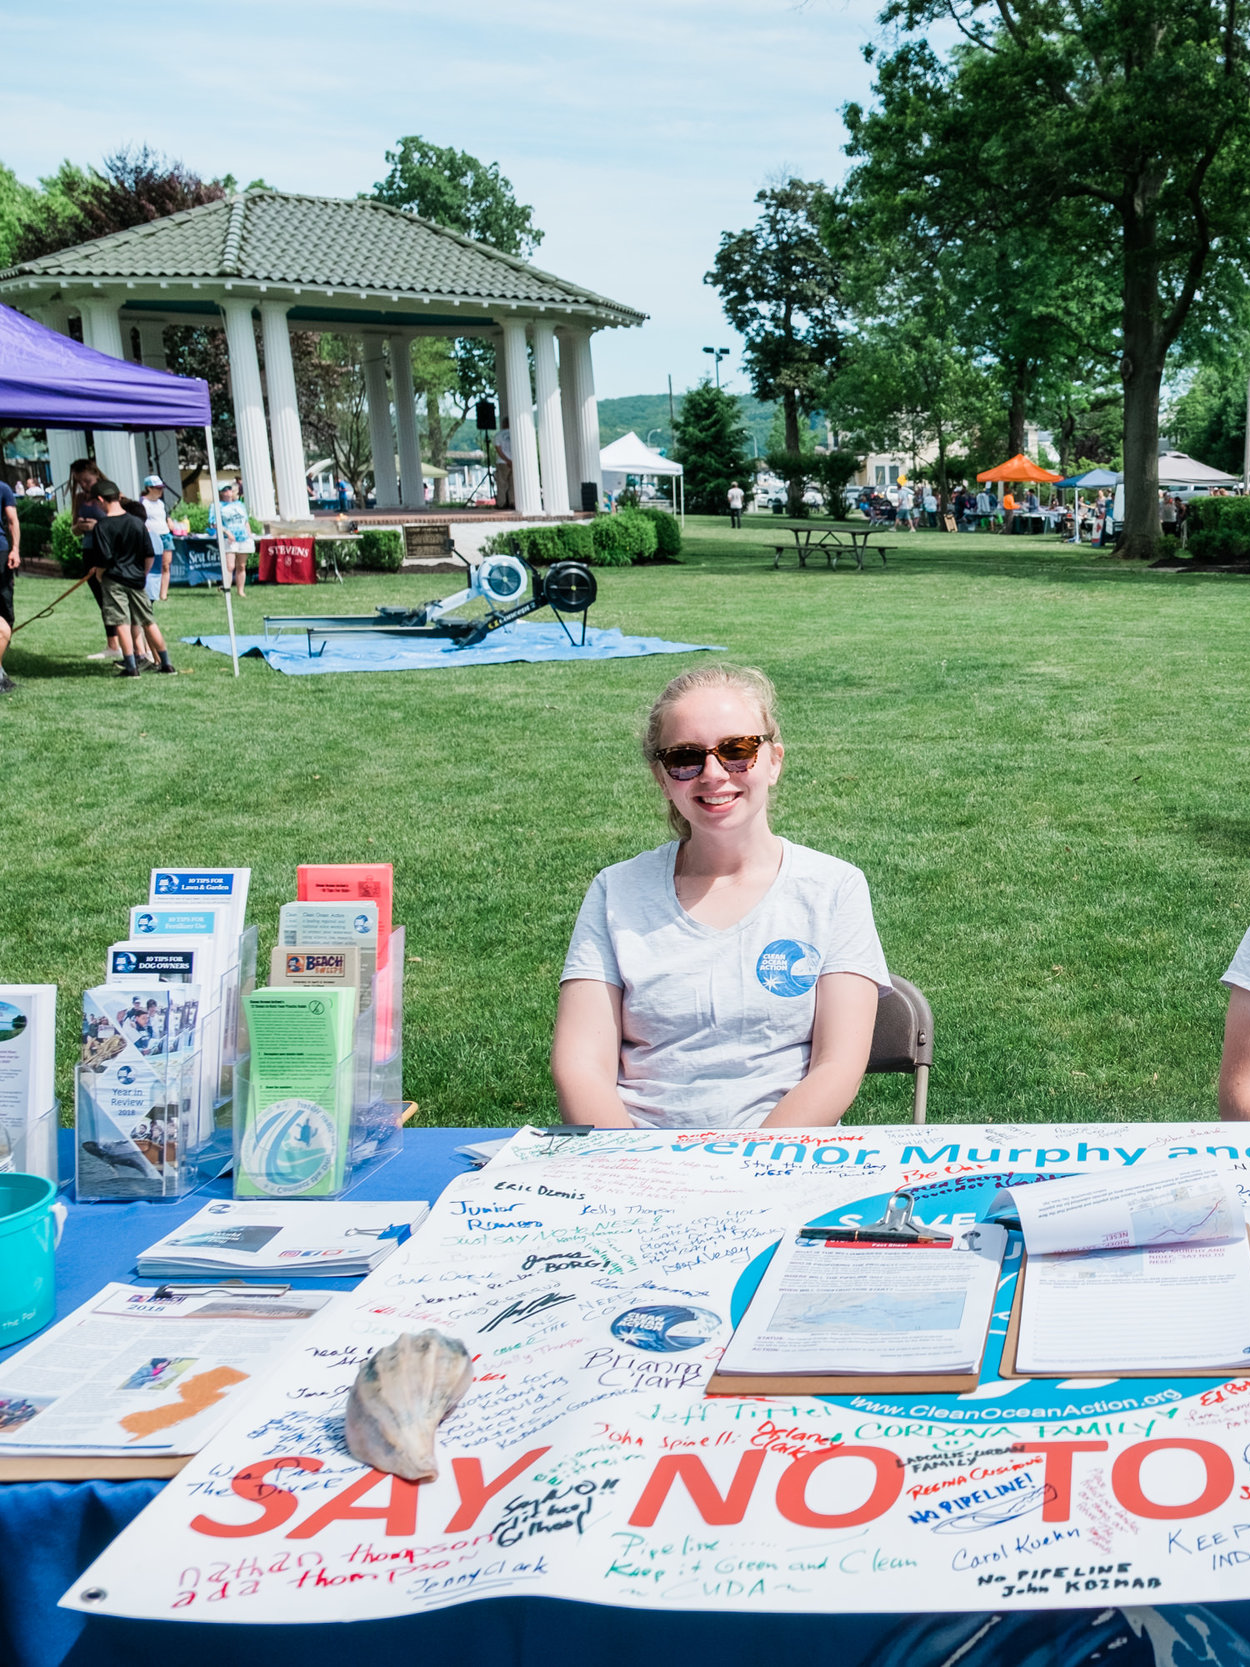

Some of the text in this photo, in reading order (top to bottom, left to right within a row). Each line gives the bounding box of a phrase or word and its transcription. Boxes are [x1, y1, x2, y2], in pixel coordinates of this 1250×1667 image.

[189, 551, 205, 564] Sea
[268, 545, 309, 557] STEVENS
[306, 956, 343, 970] BEACH
[112, 1088, 143, 1096] Year in
[111, 1098, 144, 1106] Review
[900, 1143, 1146, 1167] Murphy
[740, 1160, 774, 1171] Stop
[902, 1169, 938, 1182] Be
[450, 1200, 526, 1216] Junior
[579, 1204, 616, 1215] Kelly
[494, 1234, 528, 1245] SAY
[532, 1228, 568, 1242] NO
[543, 1260, 611, 1274] BORG!
[127, 1304, 166, 1312] 2018
[627, 1311, 665, 1321] CLEAN
[618, 1322, 662, 1331] ACTION
[598, 1367, 705, 1390] Clark
[850, 1388, 1183, 1420] www.CleanOceanAction.org
[637, 1403, 718, 1426] Jeff
[594, 1422, 643, 1447] John
[854, 1419, 1156, 1439] CORDOVA FAMILY
[912, 1457, 977, 1473] FAMILY
[187, 1481, 235, 1497] The
[190, 1446, 553, 1539] SAY
[628, 1446, 905, 1529] NO
[1012, 1438, 1235, 1523] TO
[938, 1472, 1036, 1515] PIPELINE!
[611, 1532, 721, 1559] Pipeline
[179, 1534, 494, 1588] nathan thompson
[604, 1548, 918, 1583] Keep it Green and Clean
[952, 1545, 1008, 1571] Carol
[406, 1556, 549, 1594] Jenny Clark
[978, 1562, 1132, 1586] No PIPELINE
[171, 1580, 260, 1608] ada
[660, 1578, 765, 1599] CUDA
[1001, 1584, 1050, 1598] John
